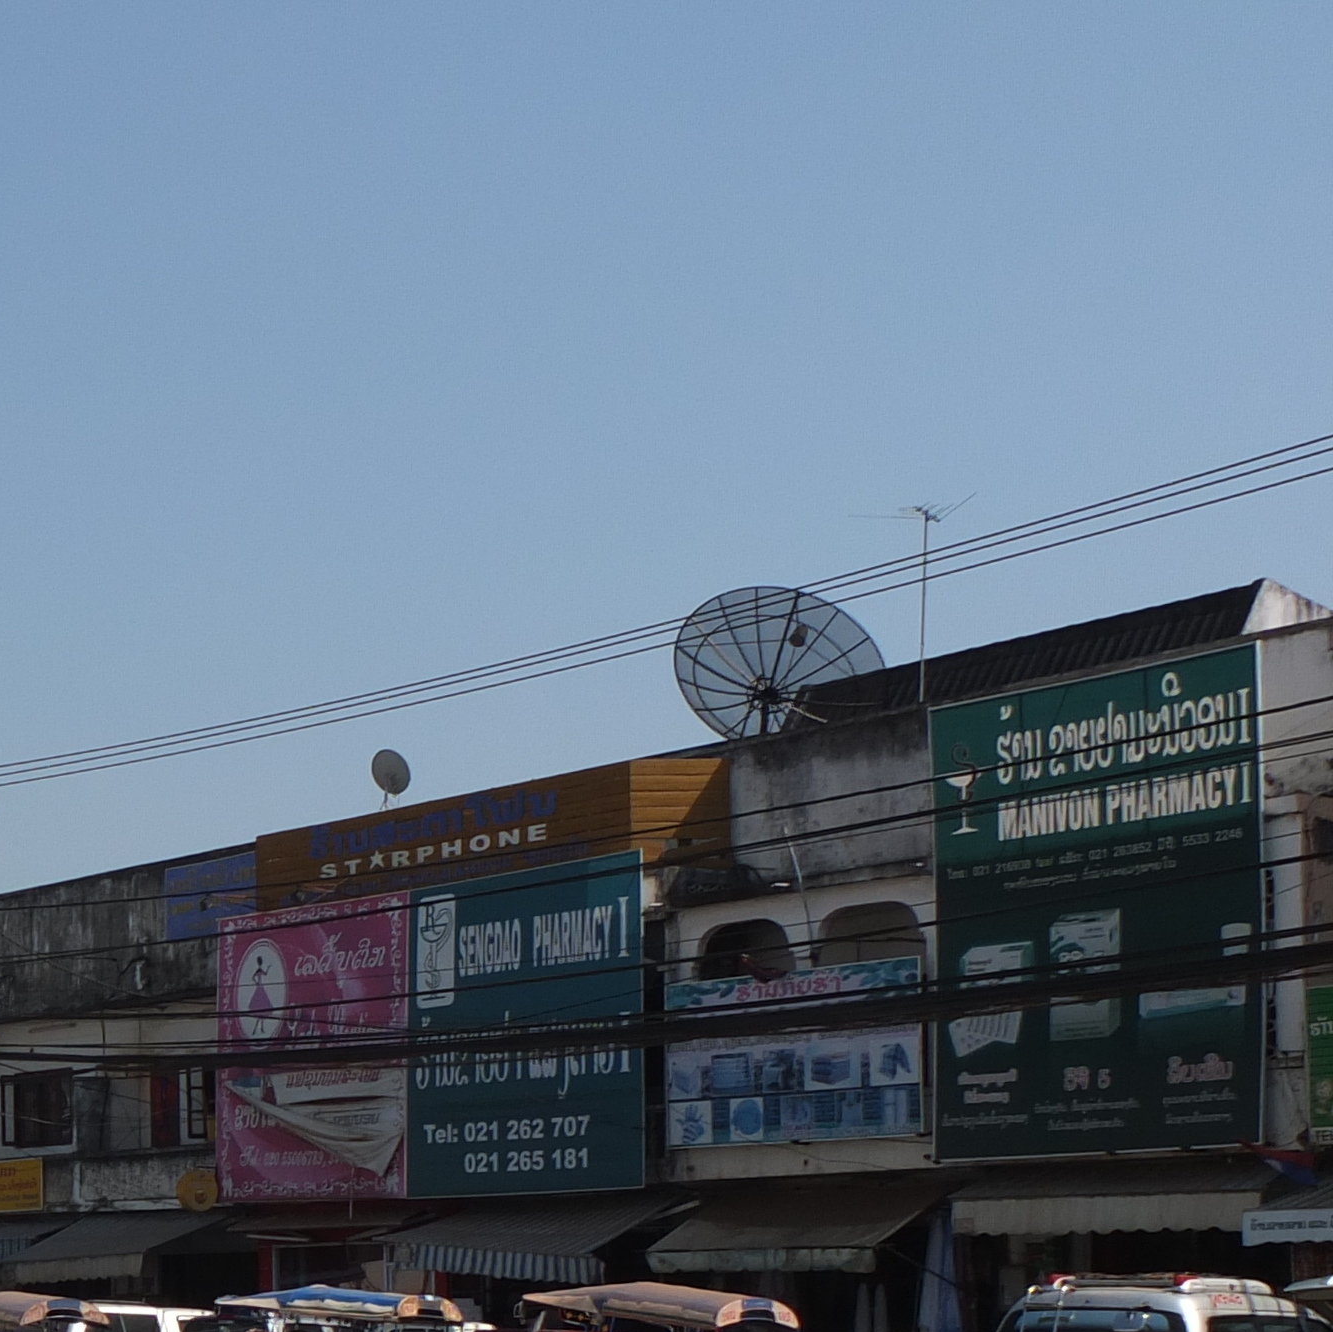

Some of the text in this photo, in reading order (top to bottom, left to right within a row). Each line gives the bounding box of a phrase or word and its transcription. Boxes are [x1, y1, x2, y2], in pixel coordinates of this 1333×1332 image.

[998, 787, 1101, 842] MANIVON
[1105, 765, 1237, 826] PHARMACY
[458, 917, 522, 979] SENGDAO
[531, 904, 613, 969] PHARMACY
[423, 1114, 592, 1145] Tel: 021 262 707
[463, 1146, 590, 1175] 021 265 181
